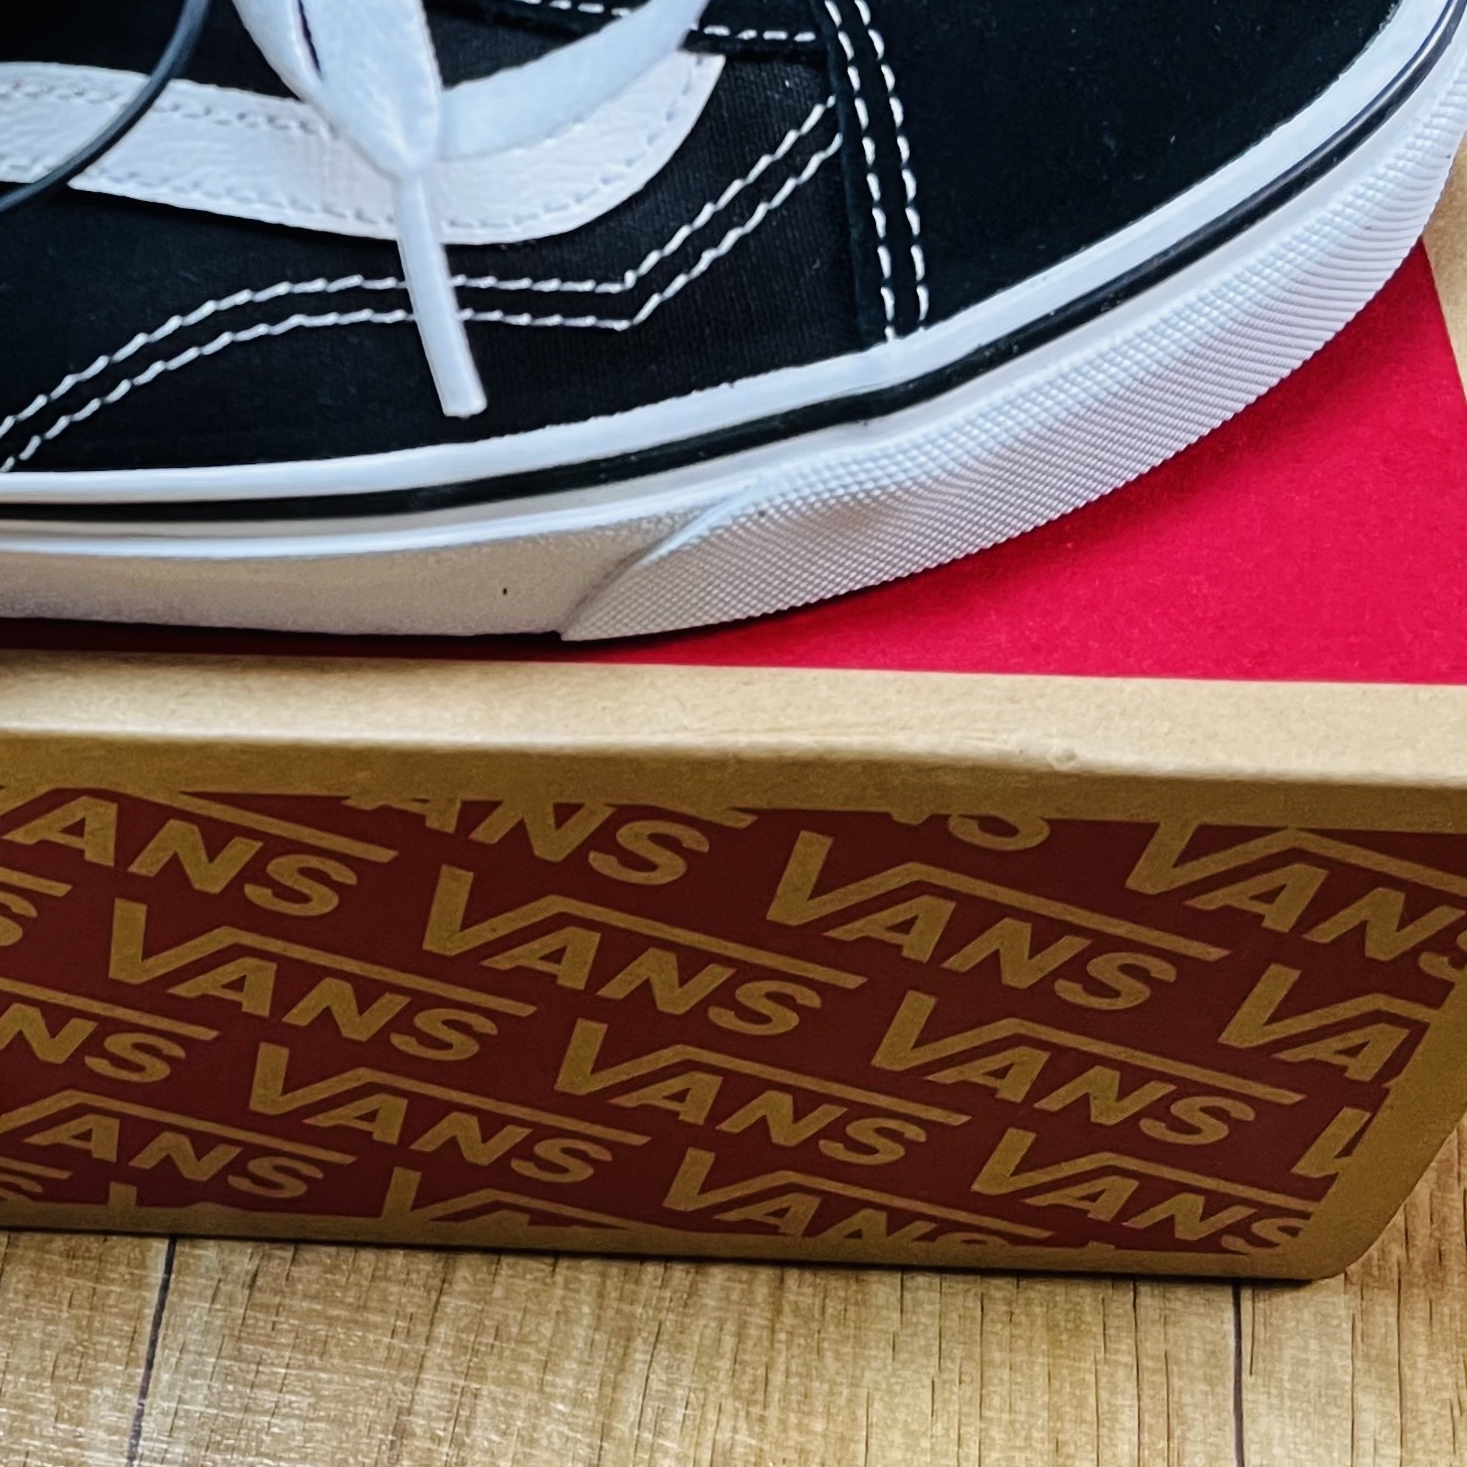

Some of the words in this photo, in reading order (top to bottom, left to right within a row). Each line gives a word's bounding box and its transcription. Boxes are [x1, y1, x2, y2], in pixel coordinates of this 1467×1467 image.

[109, 897, 537, 1061] VANS
[422, 864, 868, 1035] VANS
[766, 830, 1231, 1010] VANS
[554, 1019, 973, 1165] VANS
[870, 989, 1306, 1145] VANS
[1217, 963, 1439, 1082] VA
[249, 1042, 652, 1183] VANS
[970, 1127, 1321, 1255] VANS
